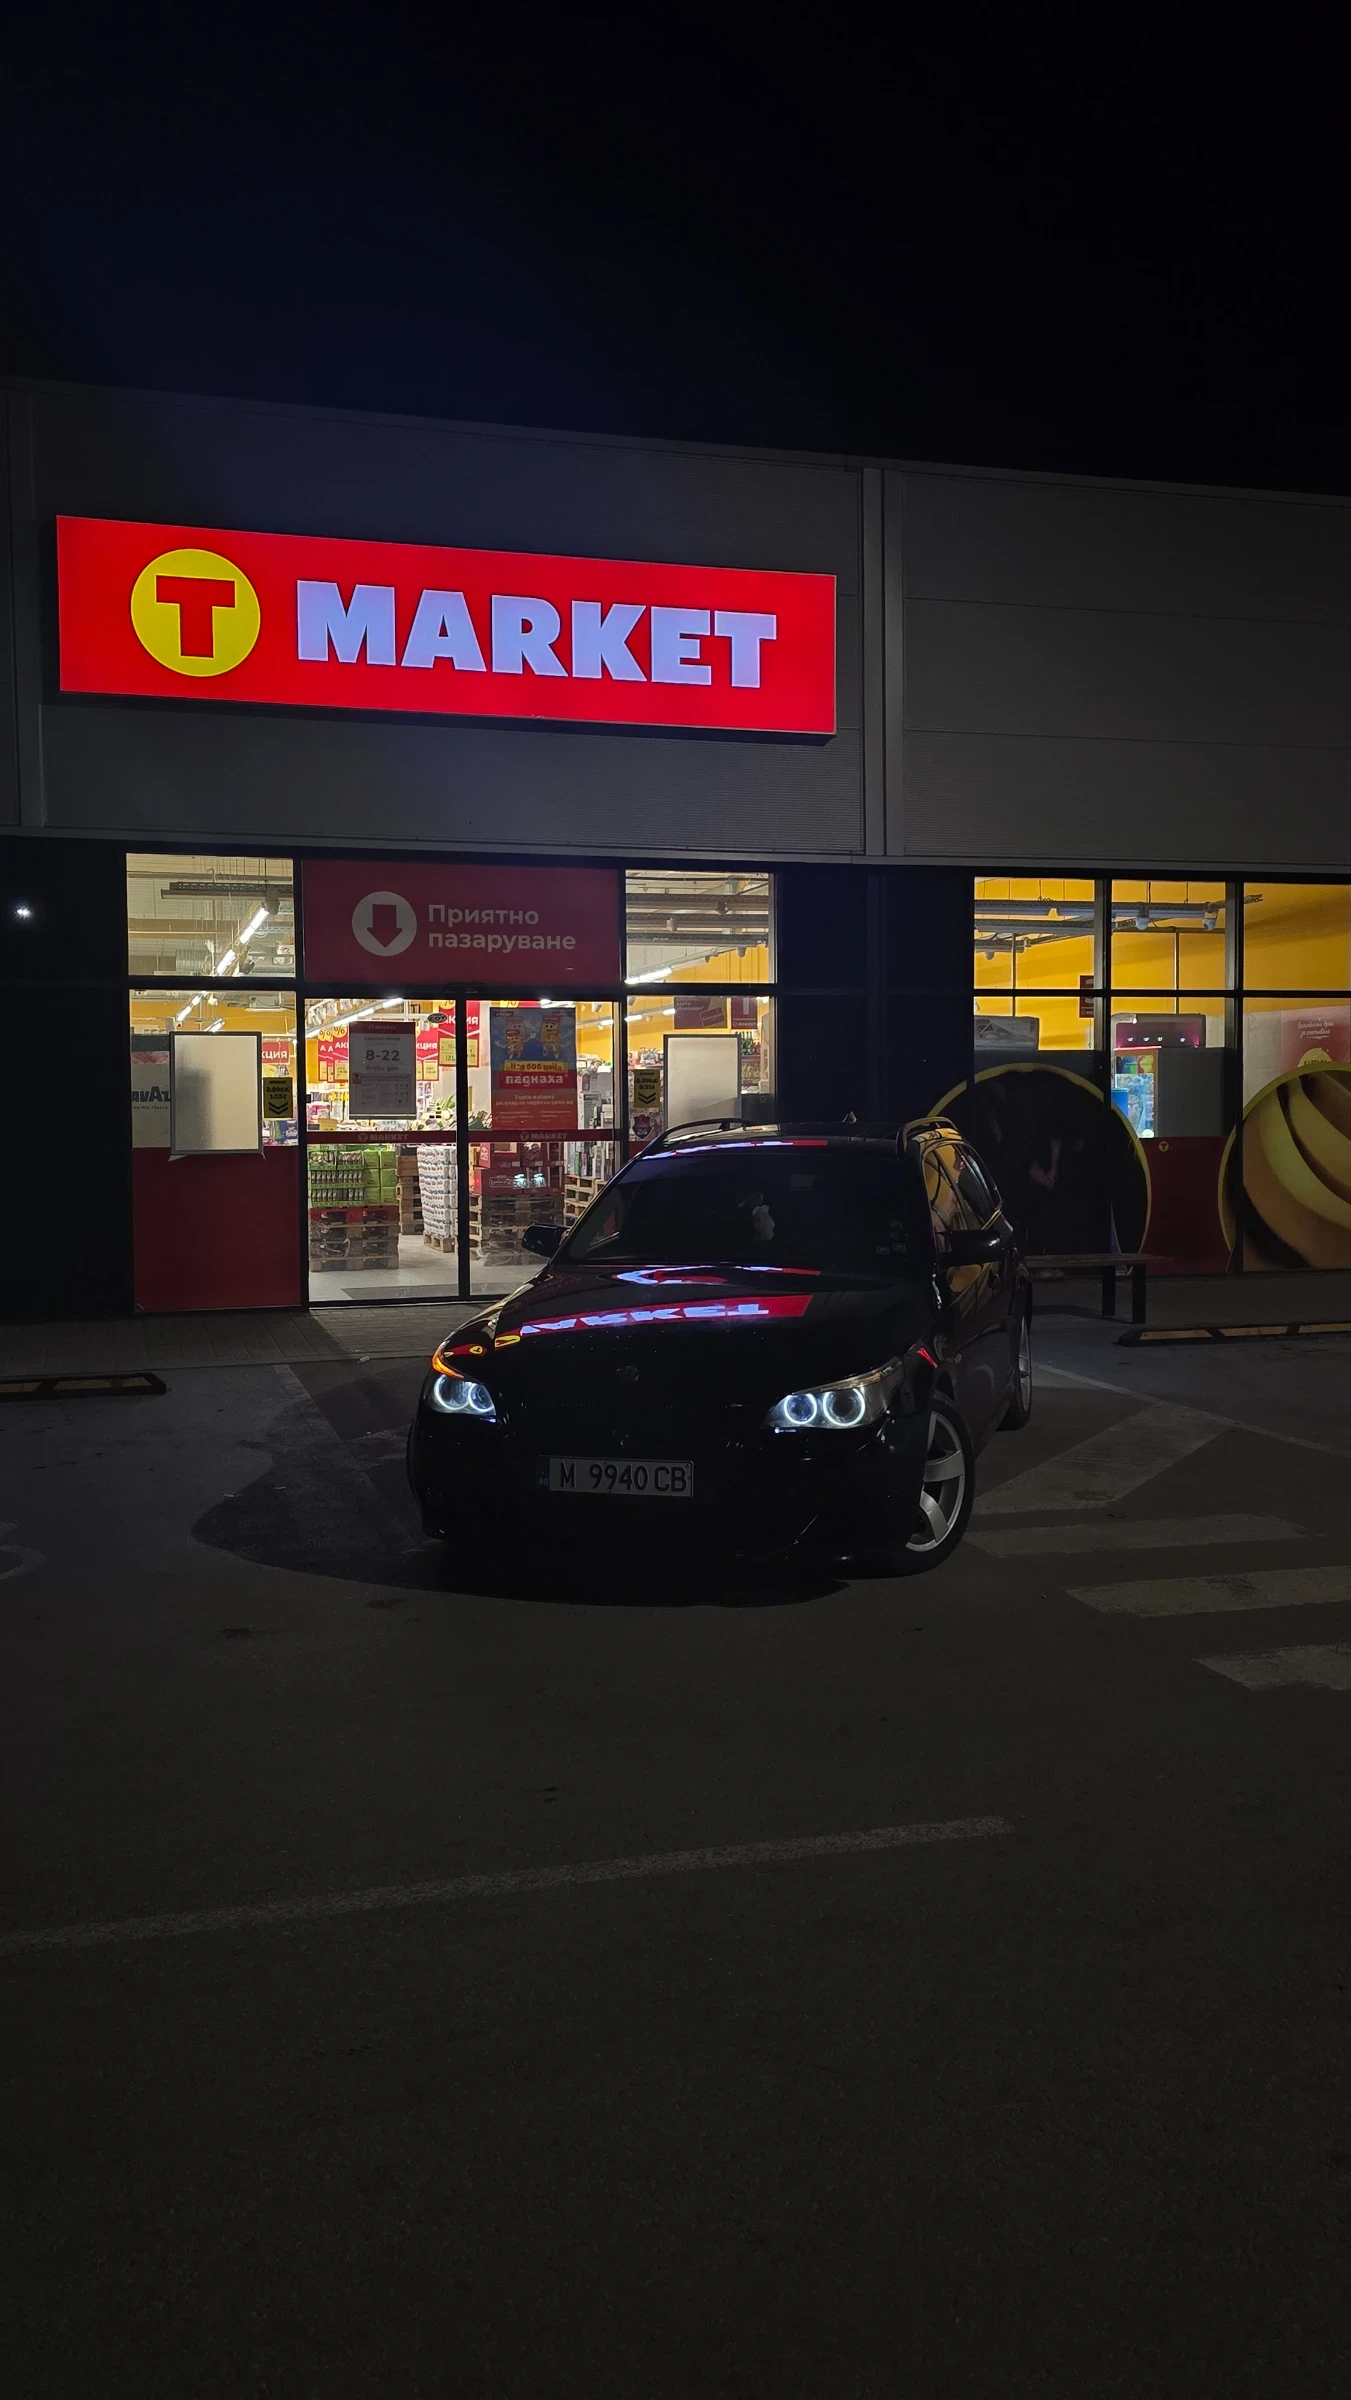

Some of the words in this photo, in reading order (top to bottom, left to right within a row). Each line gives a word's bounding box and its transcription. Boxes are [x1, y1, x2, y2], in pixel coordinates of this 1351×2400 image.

[155, 574, 236, 658] T
[296, 579, 777, 688] MARKET
[428, 904, 539, 927] Приятно
[428, 933, 576, 953] пазаруване
[365, 1049, 400, 1061] 8-22
[370, 1133, 408, 1141] MARKET
[531, 1132, 567, 1140] MARKET
[538, 1477, 549, 1485] BG
[560, 1461, 576, 1488] M
[589, 1463, 648, 1491] 9940
[654, 1466, 687, 1492] CB
